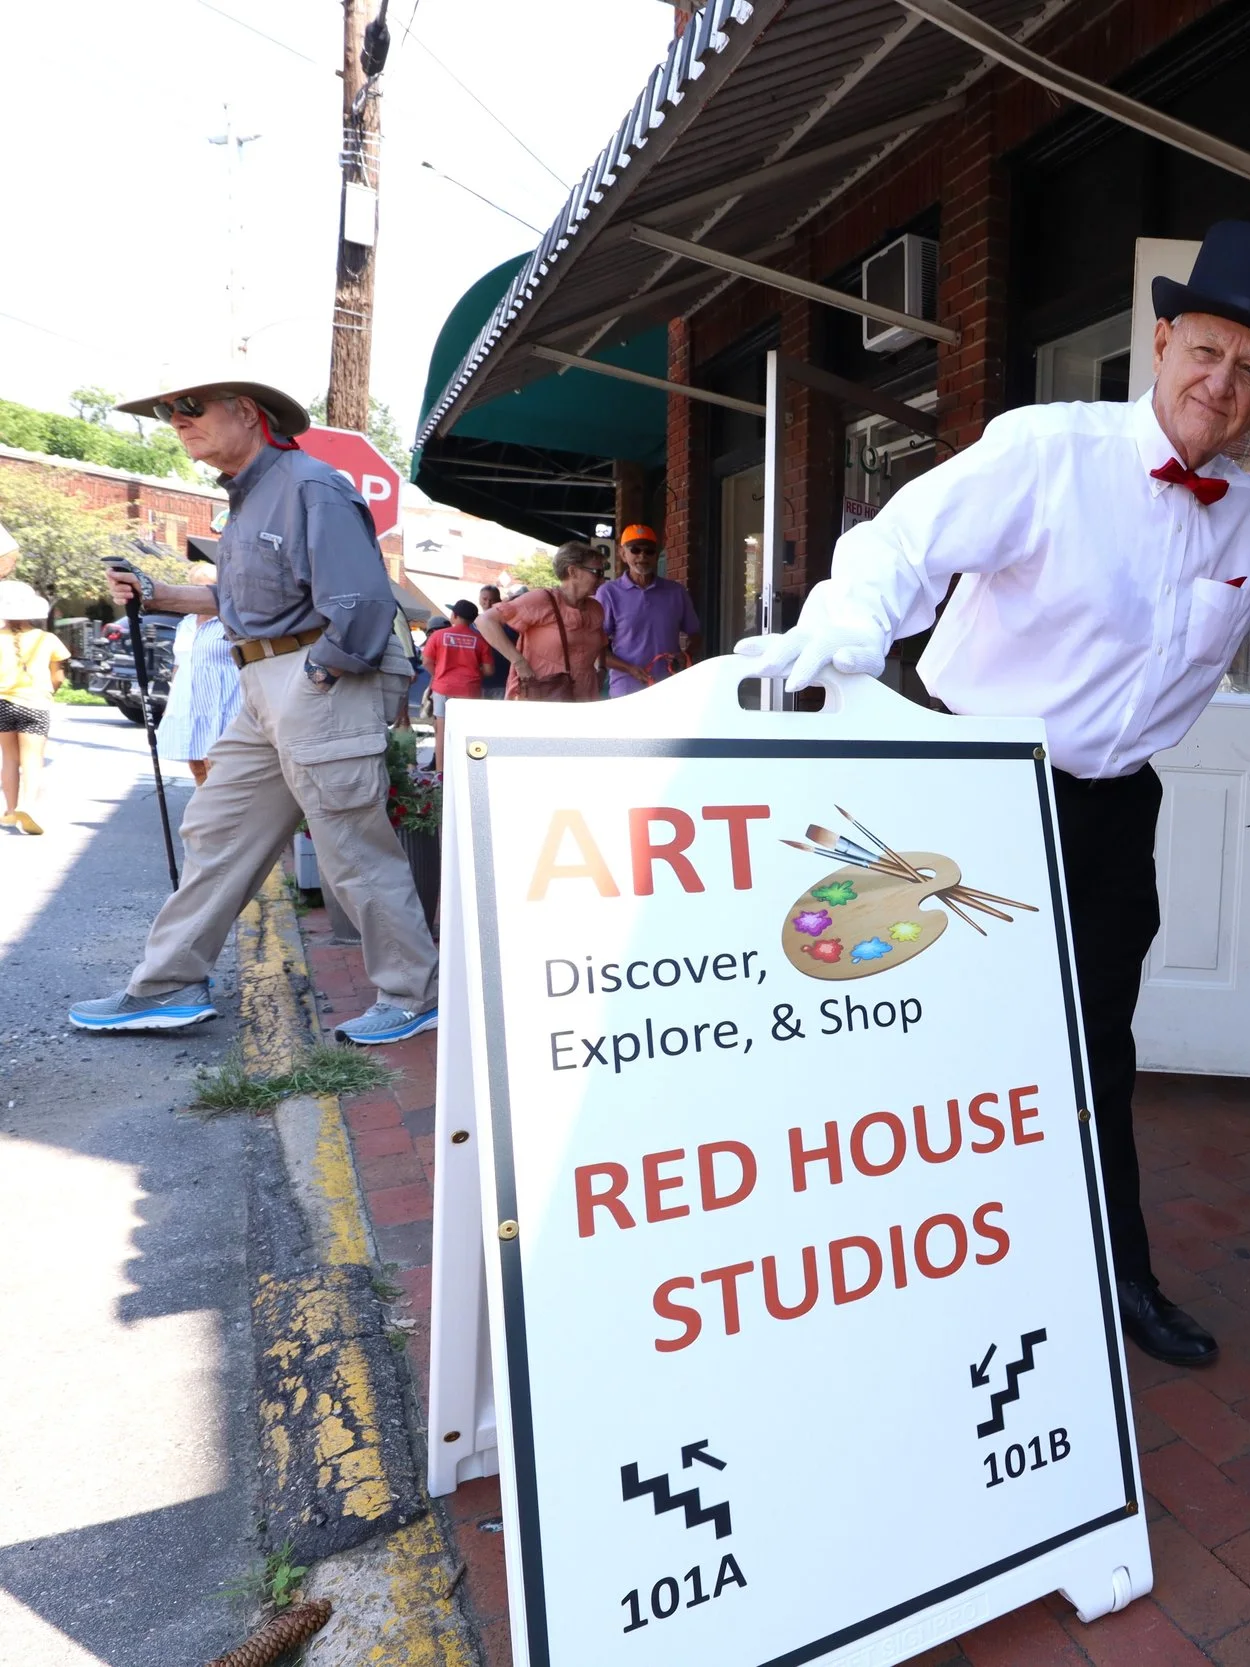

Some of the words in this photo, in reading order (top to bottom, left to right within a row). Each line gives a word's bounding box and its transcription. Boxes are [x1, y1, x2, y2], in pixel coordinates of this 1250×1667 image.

[846, 500, 863, 516] RED
[527, 804, 771, 900] ART
[546, 950, 767, 998] Discover,
[550, 1017, 753, 1074] Explore,
[771, 1003, 806, 1042] &
[819, 994, 923, 1035] Shop
[575, 1140, 758, 1238] RED
[789, 1085, 1045, 1193] HOUSE
[653, 1201, 1011, 1353] STUDIOS
[983, 1427, 1072, 1489] 101B
[620, 1552, 748, 1634] 101A
